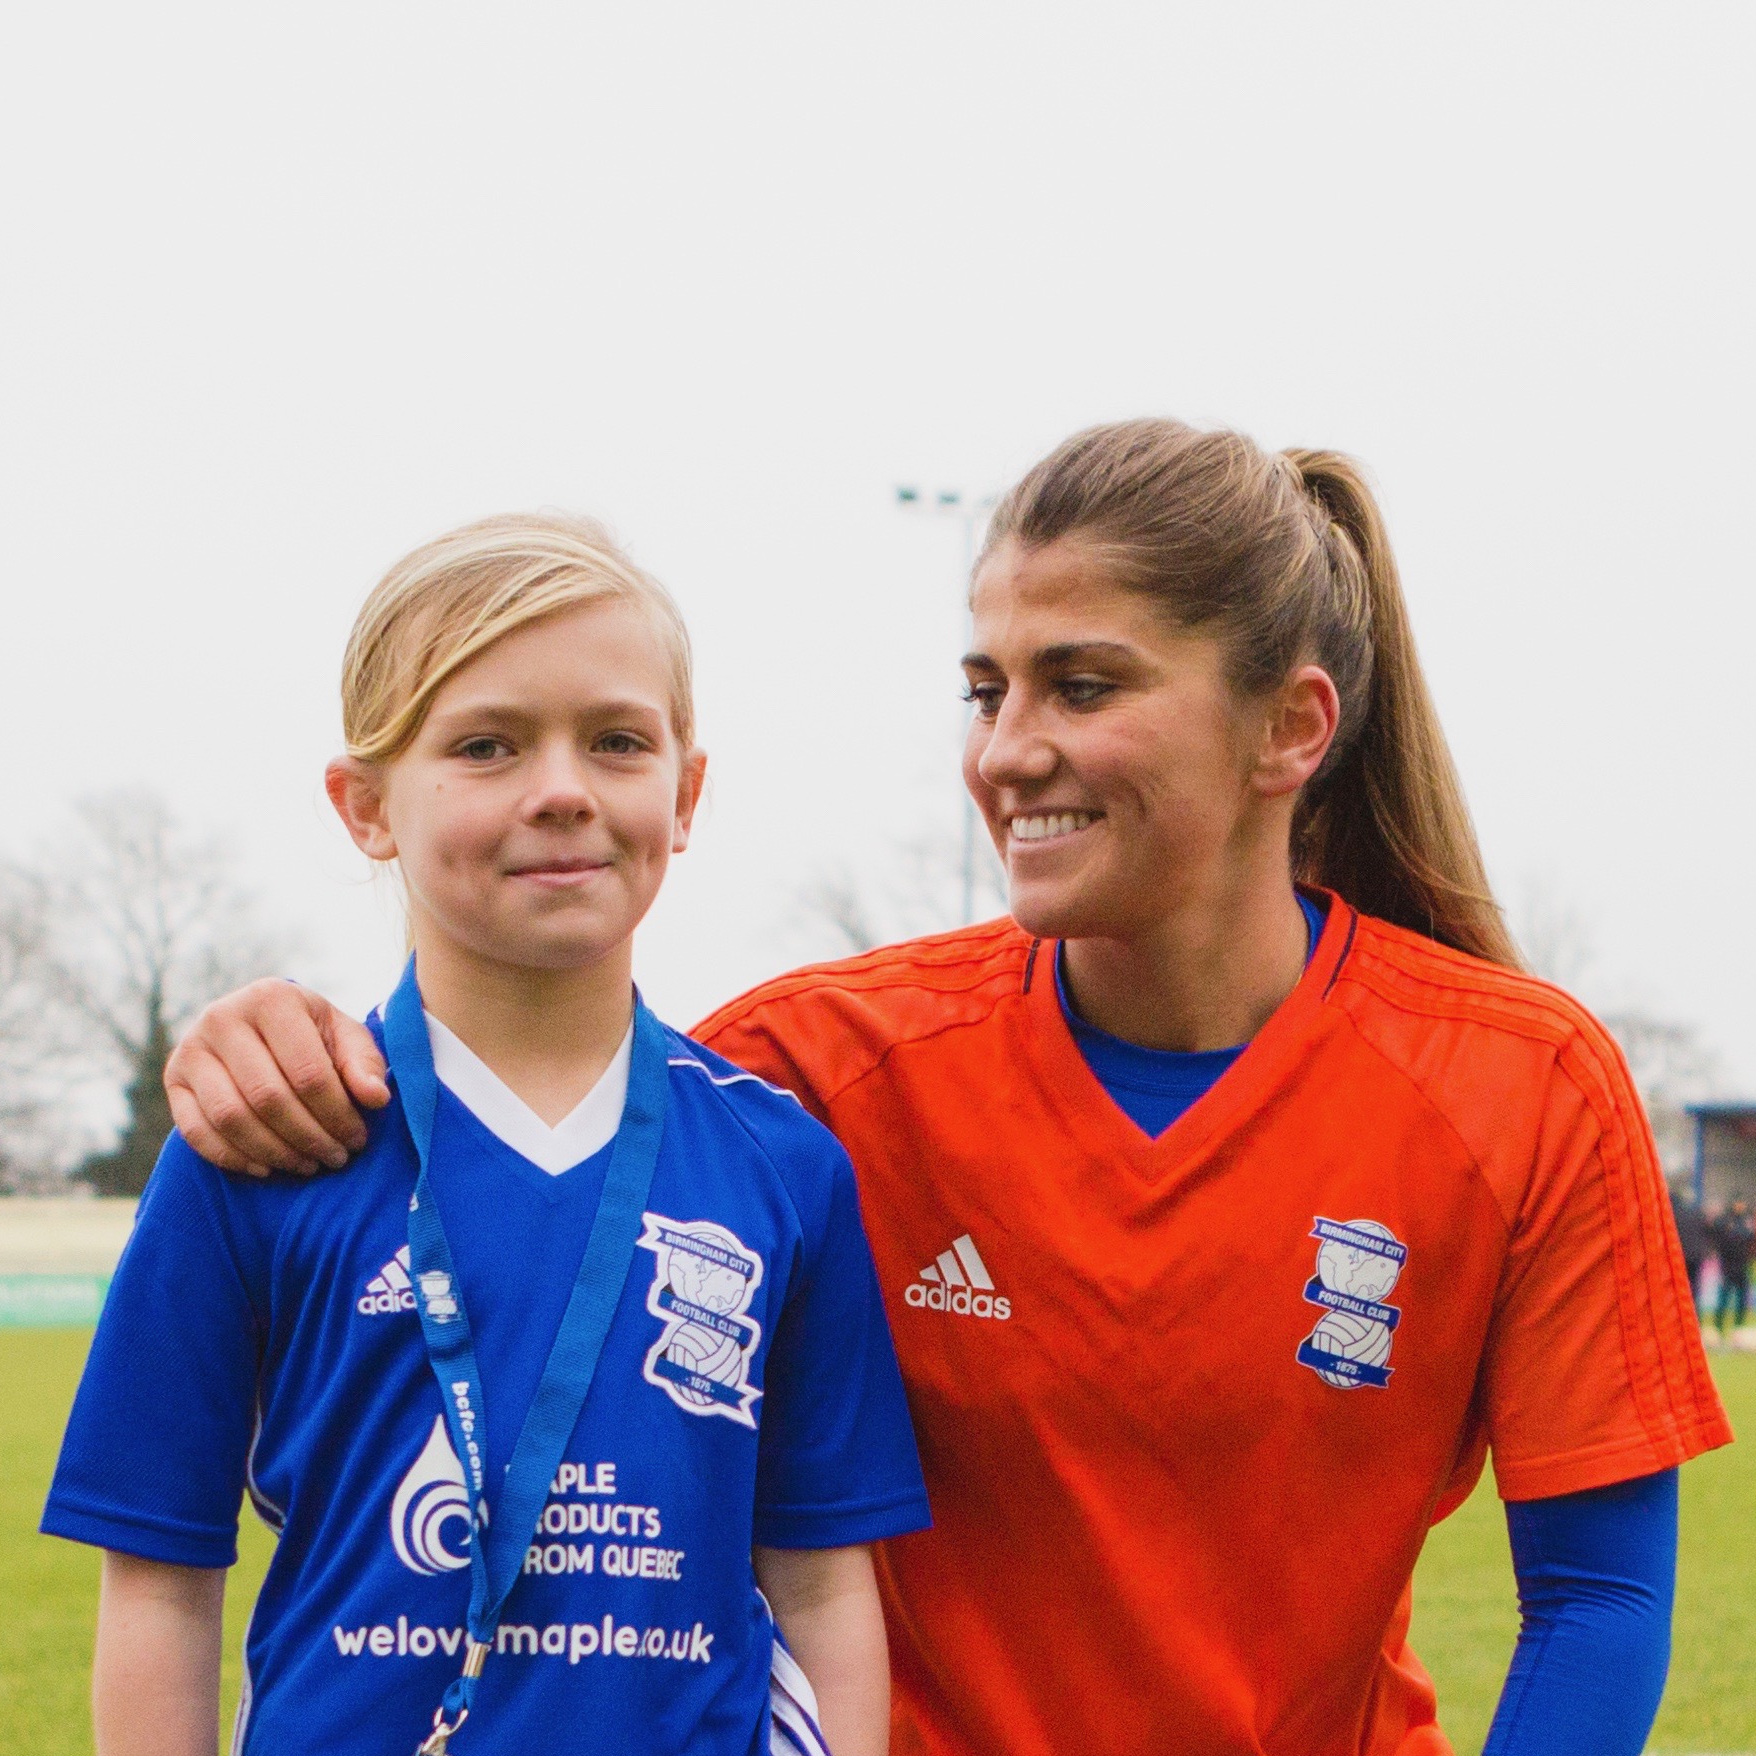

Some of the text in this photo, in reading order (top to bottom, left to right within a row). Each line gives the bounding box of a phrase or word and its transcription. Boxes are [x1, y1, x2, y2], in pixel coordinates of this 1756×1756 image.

[664, 1231, 751, 1274] BIRMINGHAM CITY
[1320, 1223, 1405, 1259] BIRMINGHAM CITY
[670, 1300, 741, 1337] FOOTBALL CLUB
[904, 1281, 1012, 1320] adidas
[1318, 1291, 1391, 1321] FOOTBALL CLUB
[535, 1503, 662, 1539] ODUCTS
[523, 1544, 685, 1581] ROM QUEBEC
